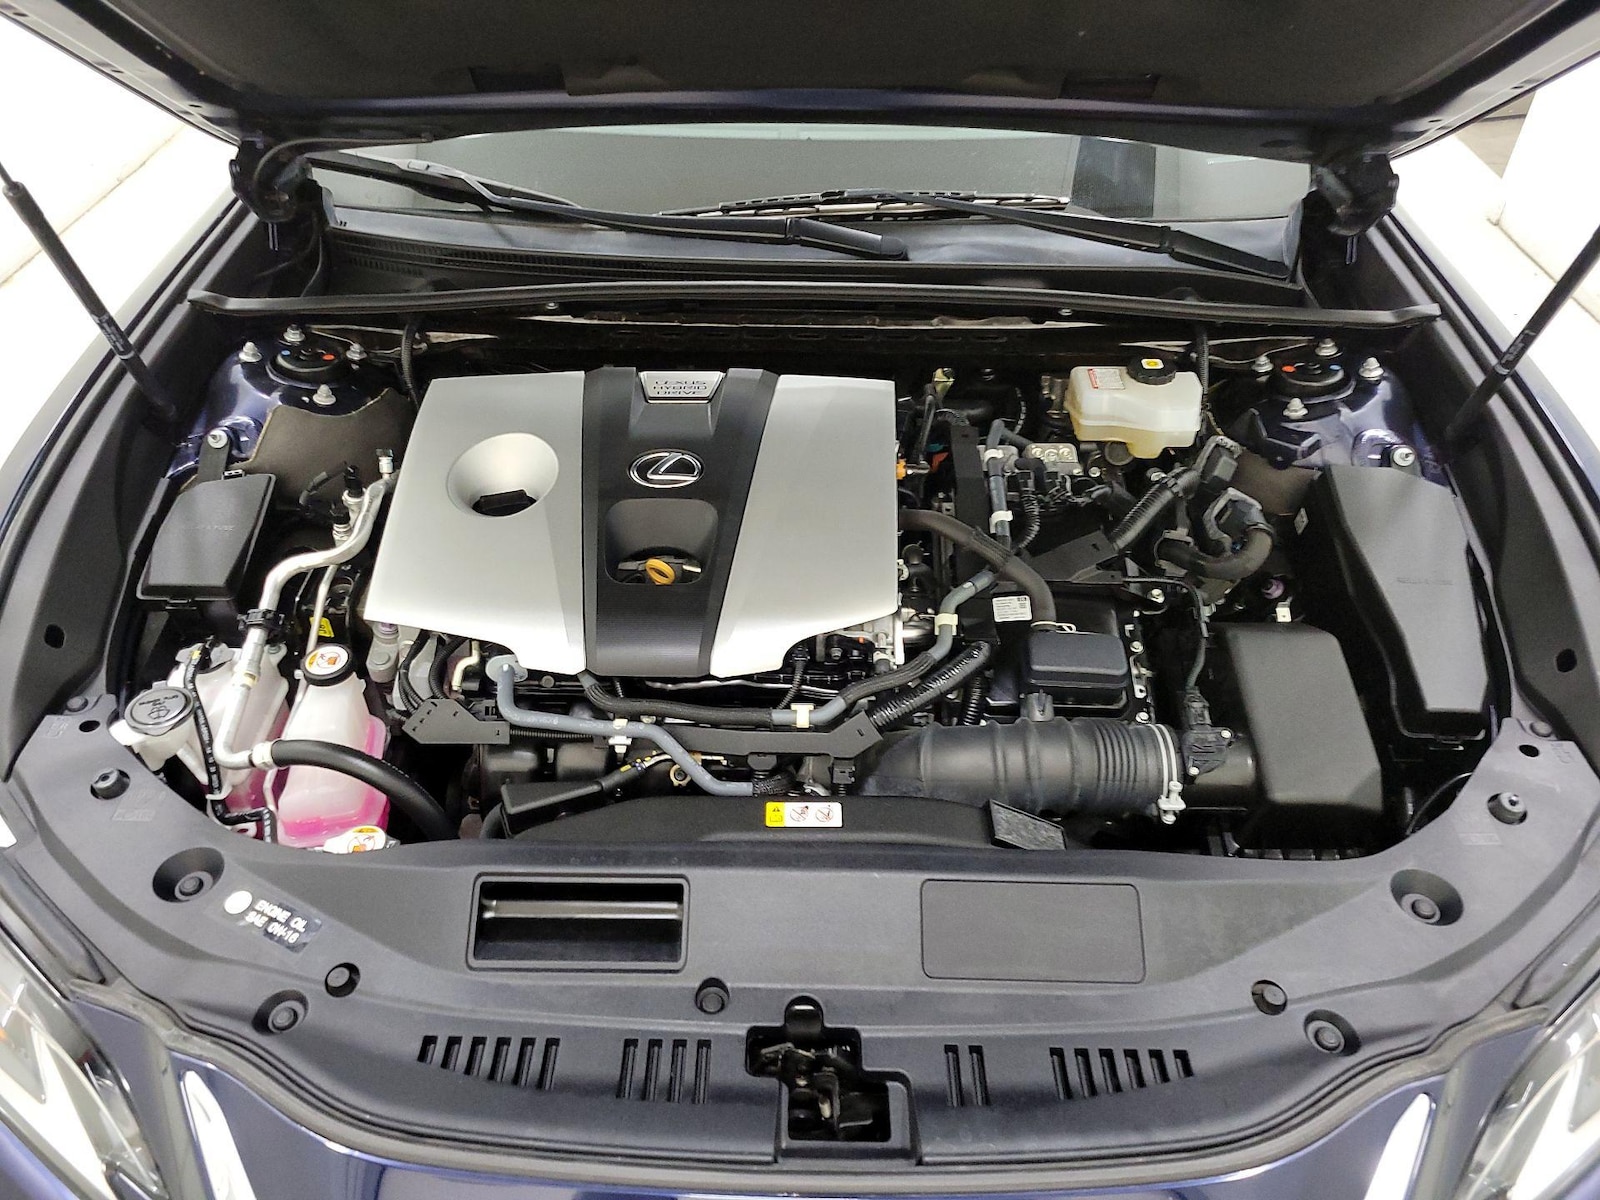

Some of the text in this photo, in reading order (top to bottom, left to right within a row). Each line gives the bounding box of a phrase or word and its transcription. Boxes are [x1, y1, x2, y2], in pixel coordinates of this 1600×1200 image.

[245, 910, 269, 928] SAE
[255, 900, 308, 933] ENGINE OIL
